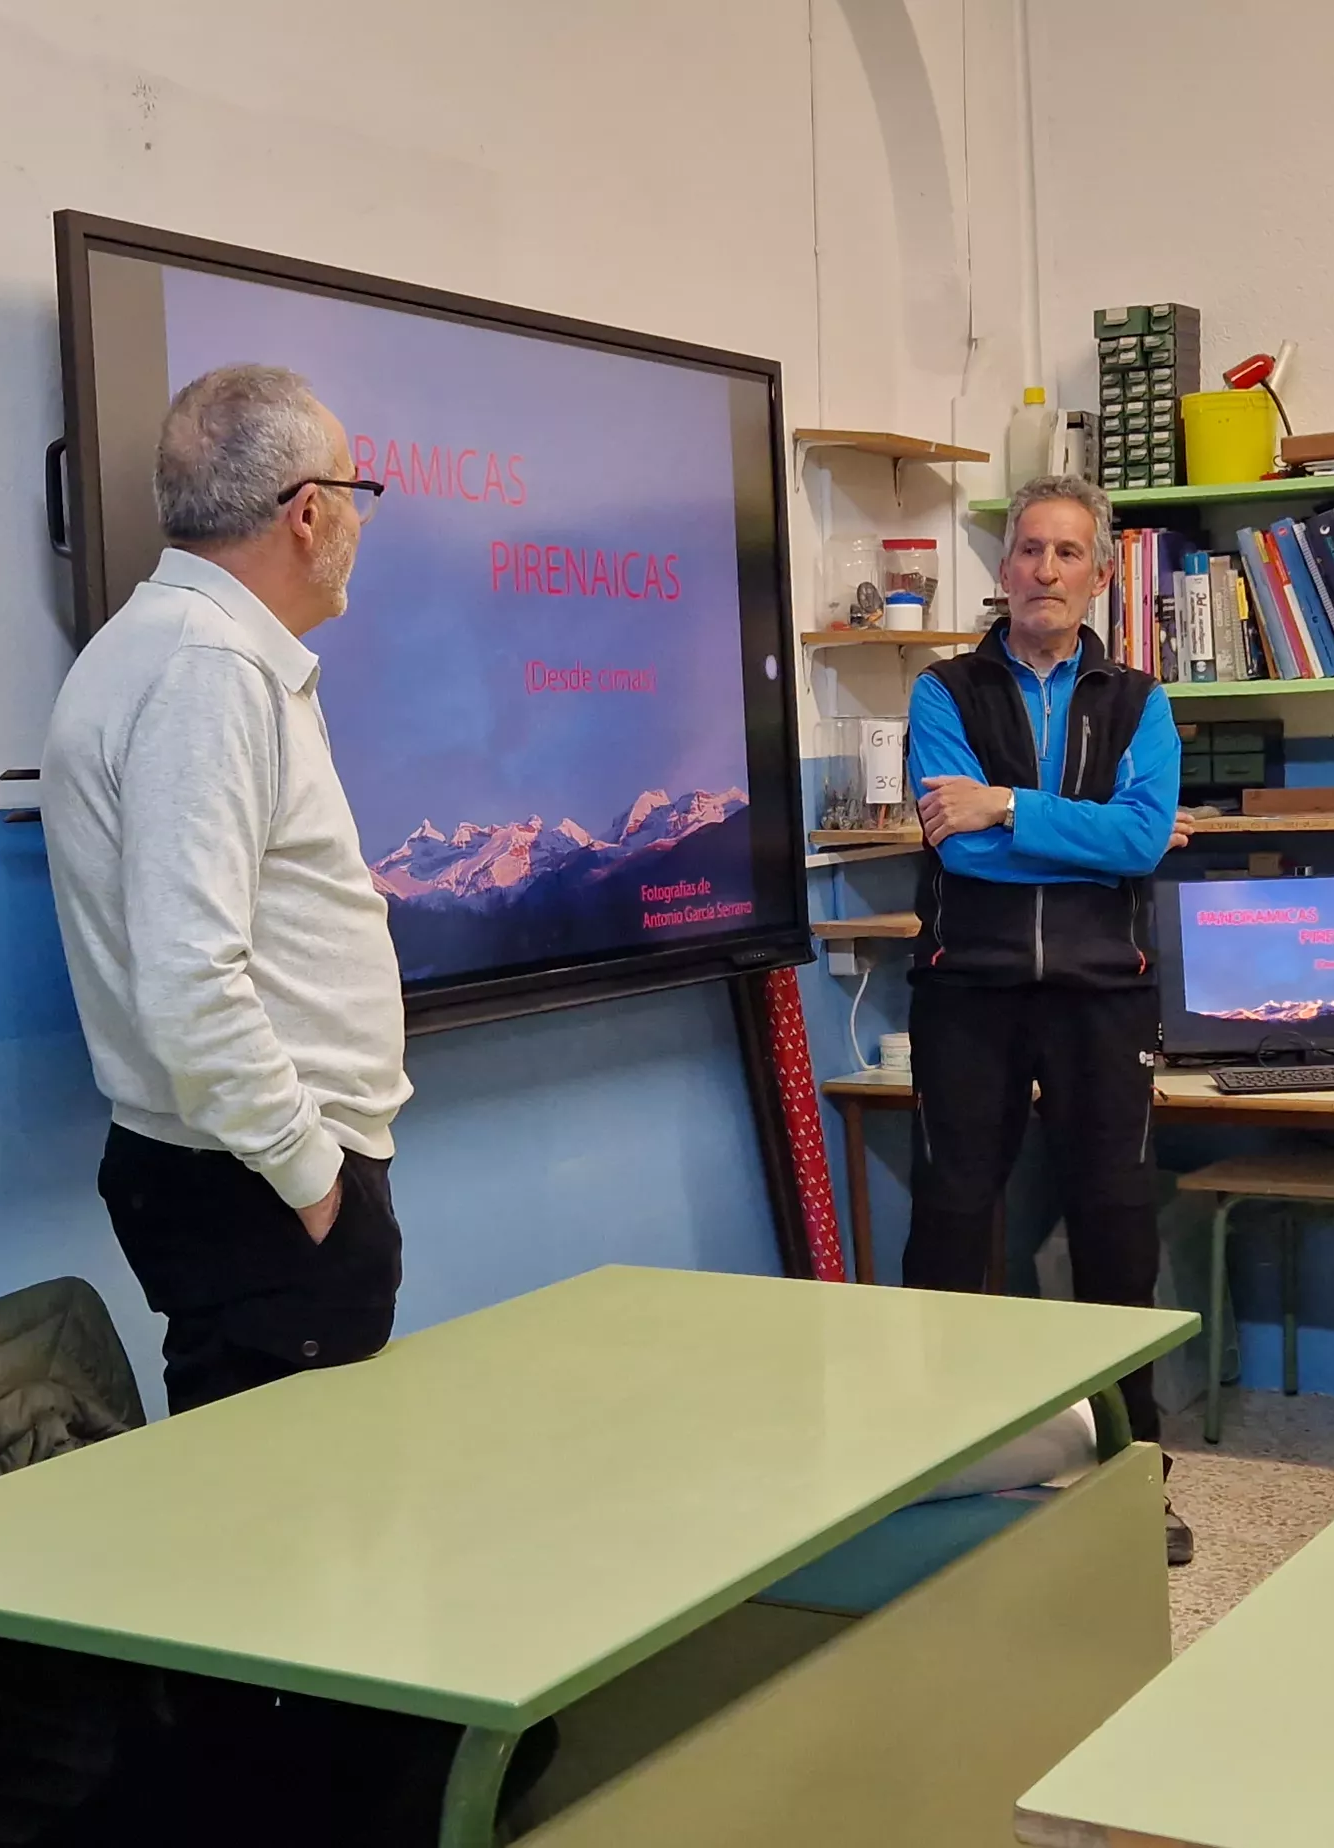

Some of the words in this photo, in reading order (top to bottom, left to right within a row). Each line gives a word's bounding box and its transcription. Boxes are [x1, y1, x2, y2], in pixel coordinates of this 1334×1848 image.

[354, 434, 527, 507] RAMICAS
[490, 540, 683, 601] PIRENAICAS
[1196, 592, 1207, 606] PC
[525, 659, 593, 695] (Desde
[597, 662, 657, 695] cimas)
[697, 876, 711, 896] de
[643, 910, 683, 929] Antonio
[685, 903, 715, 922] García
[1197, 907, 1318, 925] PANORAMICAS
